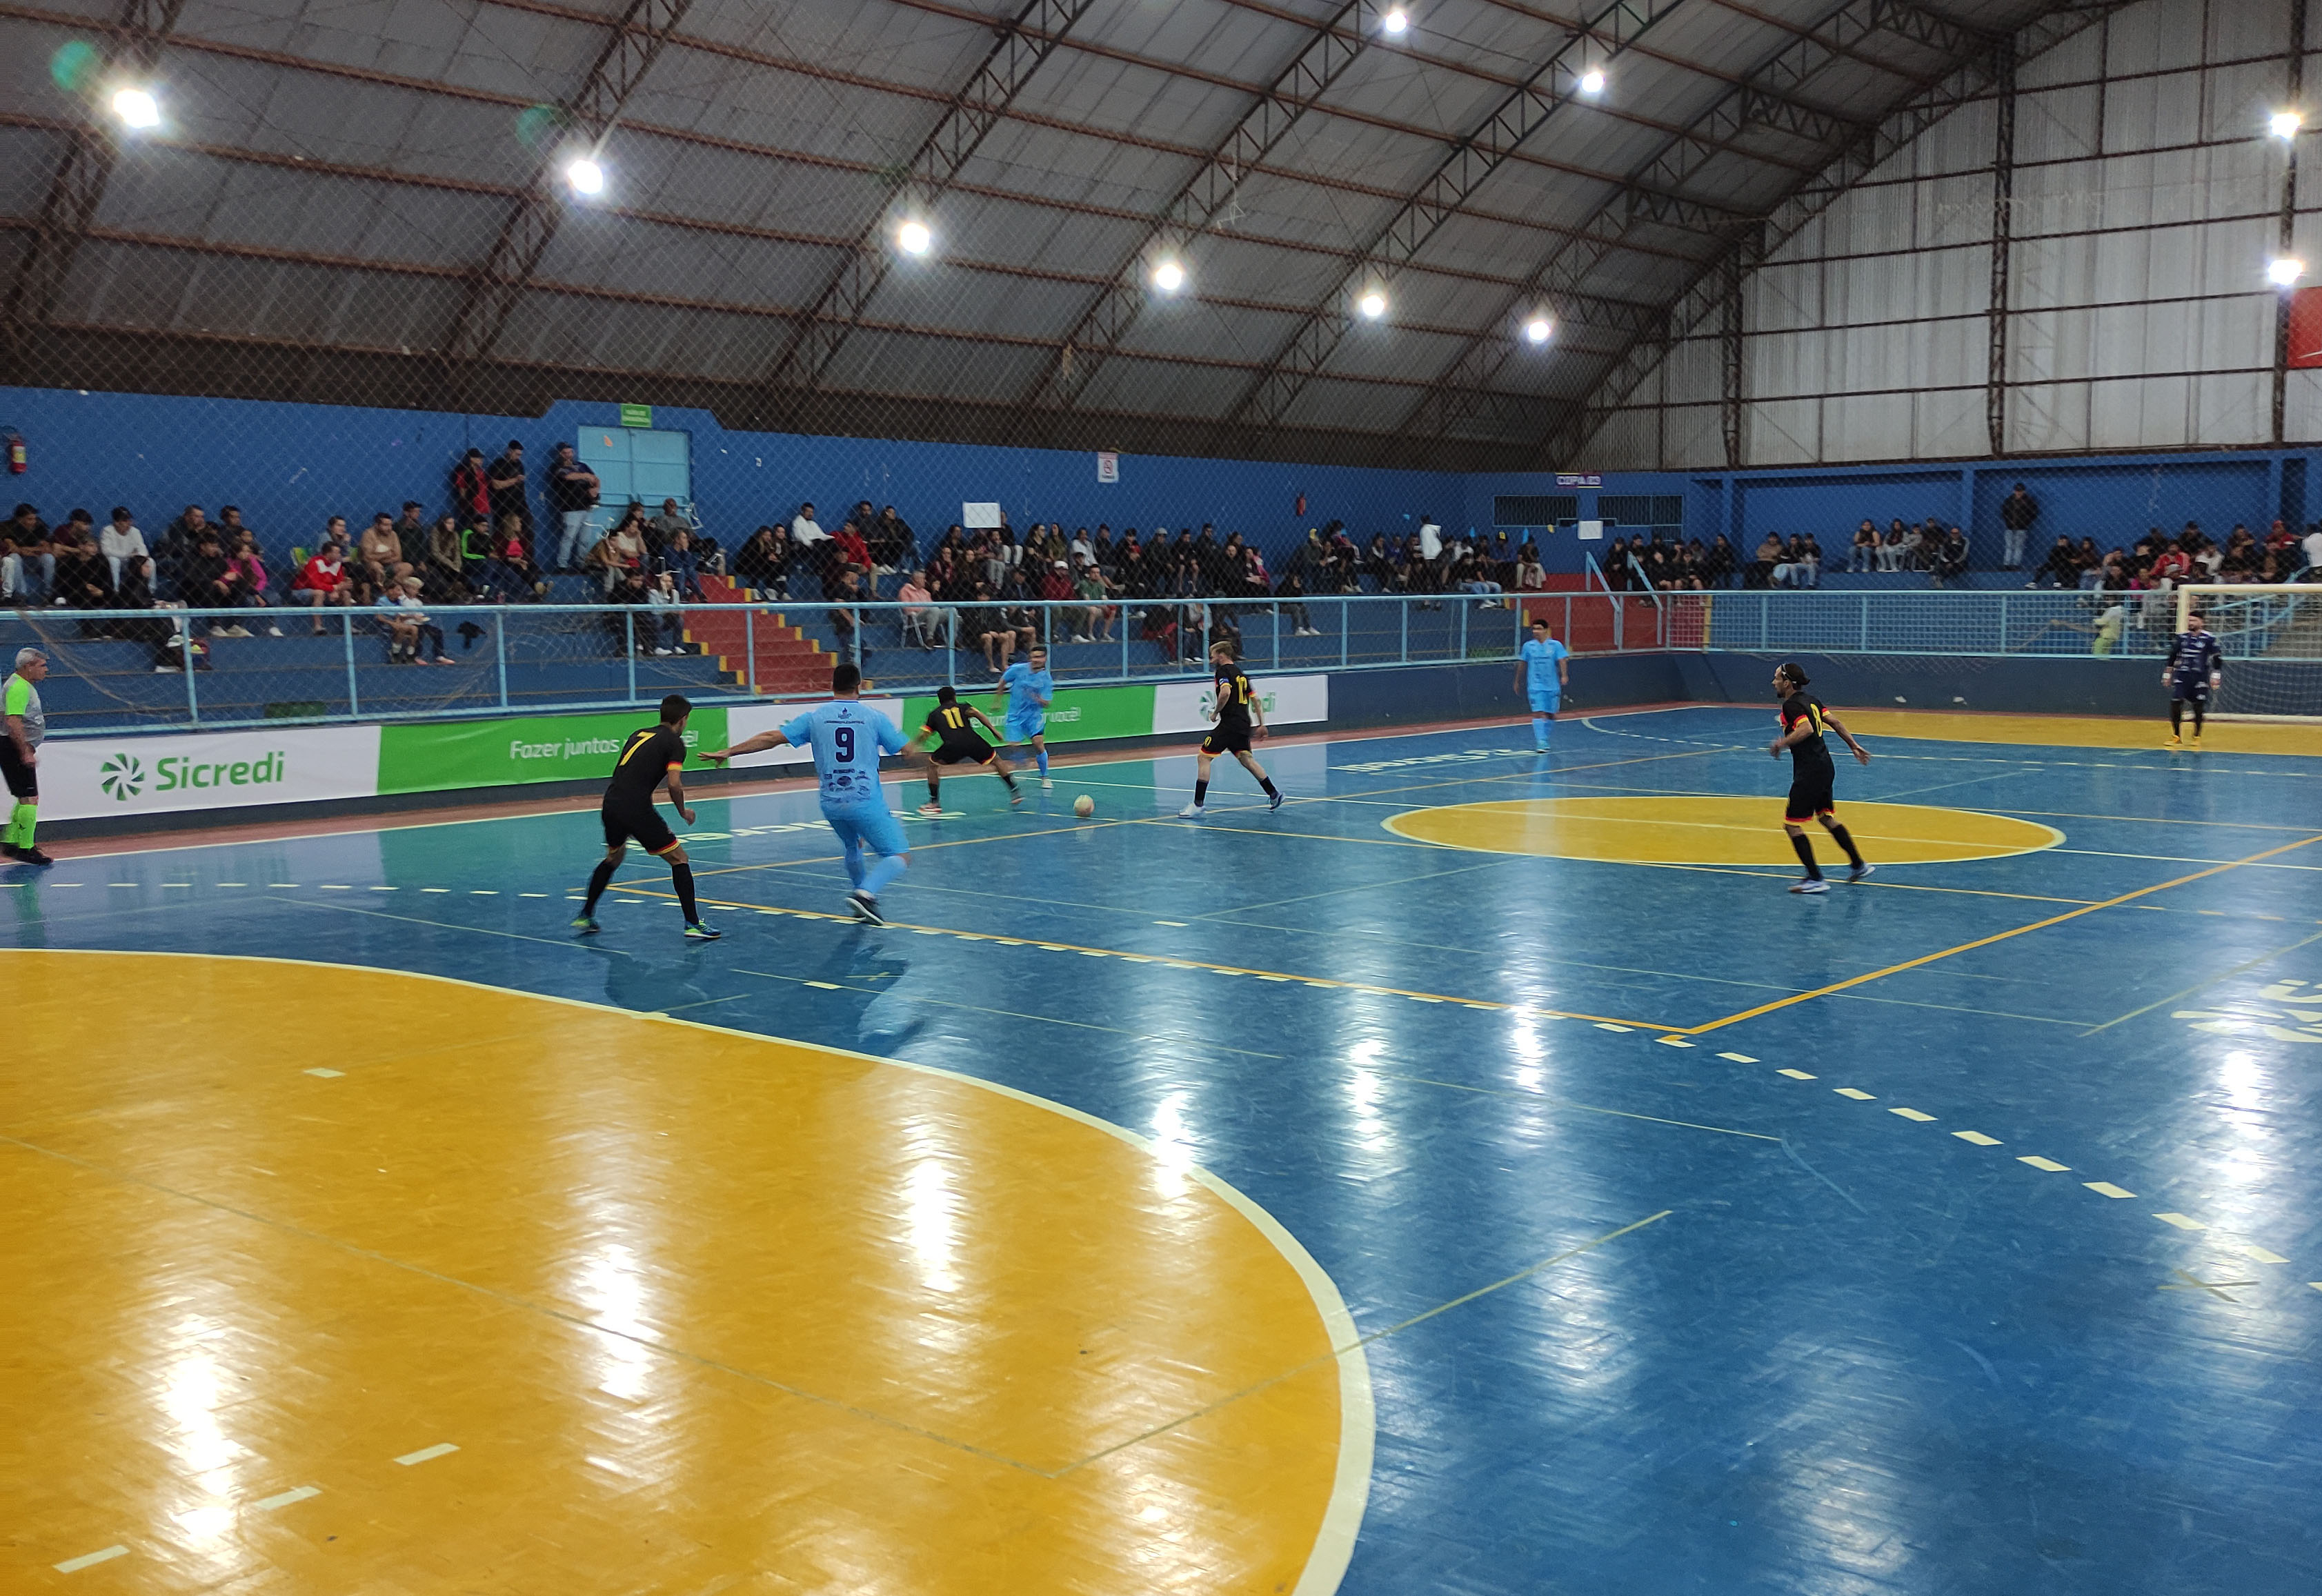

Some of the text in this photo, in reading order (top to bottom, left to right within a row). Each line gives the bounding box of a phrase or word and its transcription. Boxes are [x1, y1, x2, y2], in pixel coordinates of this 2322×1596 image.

[942, 706, 964, 729] 11
[509, 737, 619, 759] Fazer juntos
[619, 731, 657, 766] 7
[835, 726, 855, 763] 9
[155, 750, 286, 791] Sicredi
